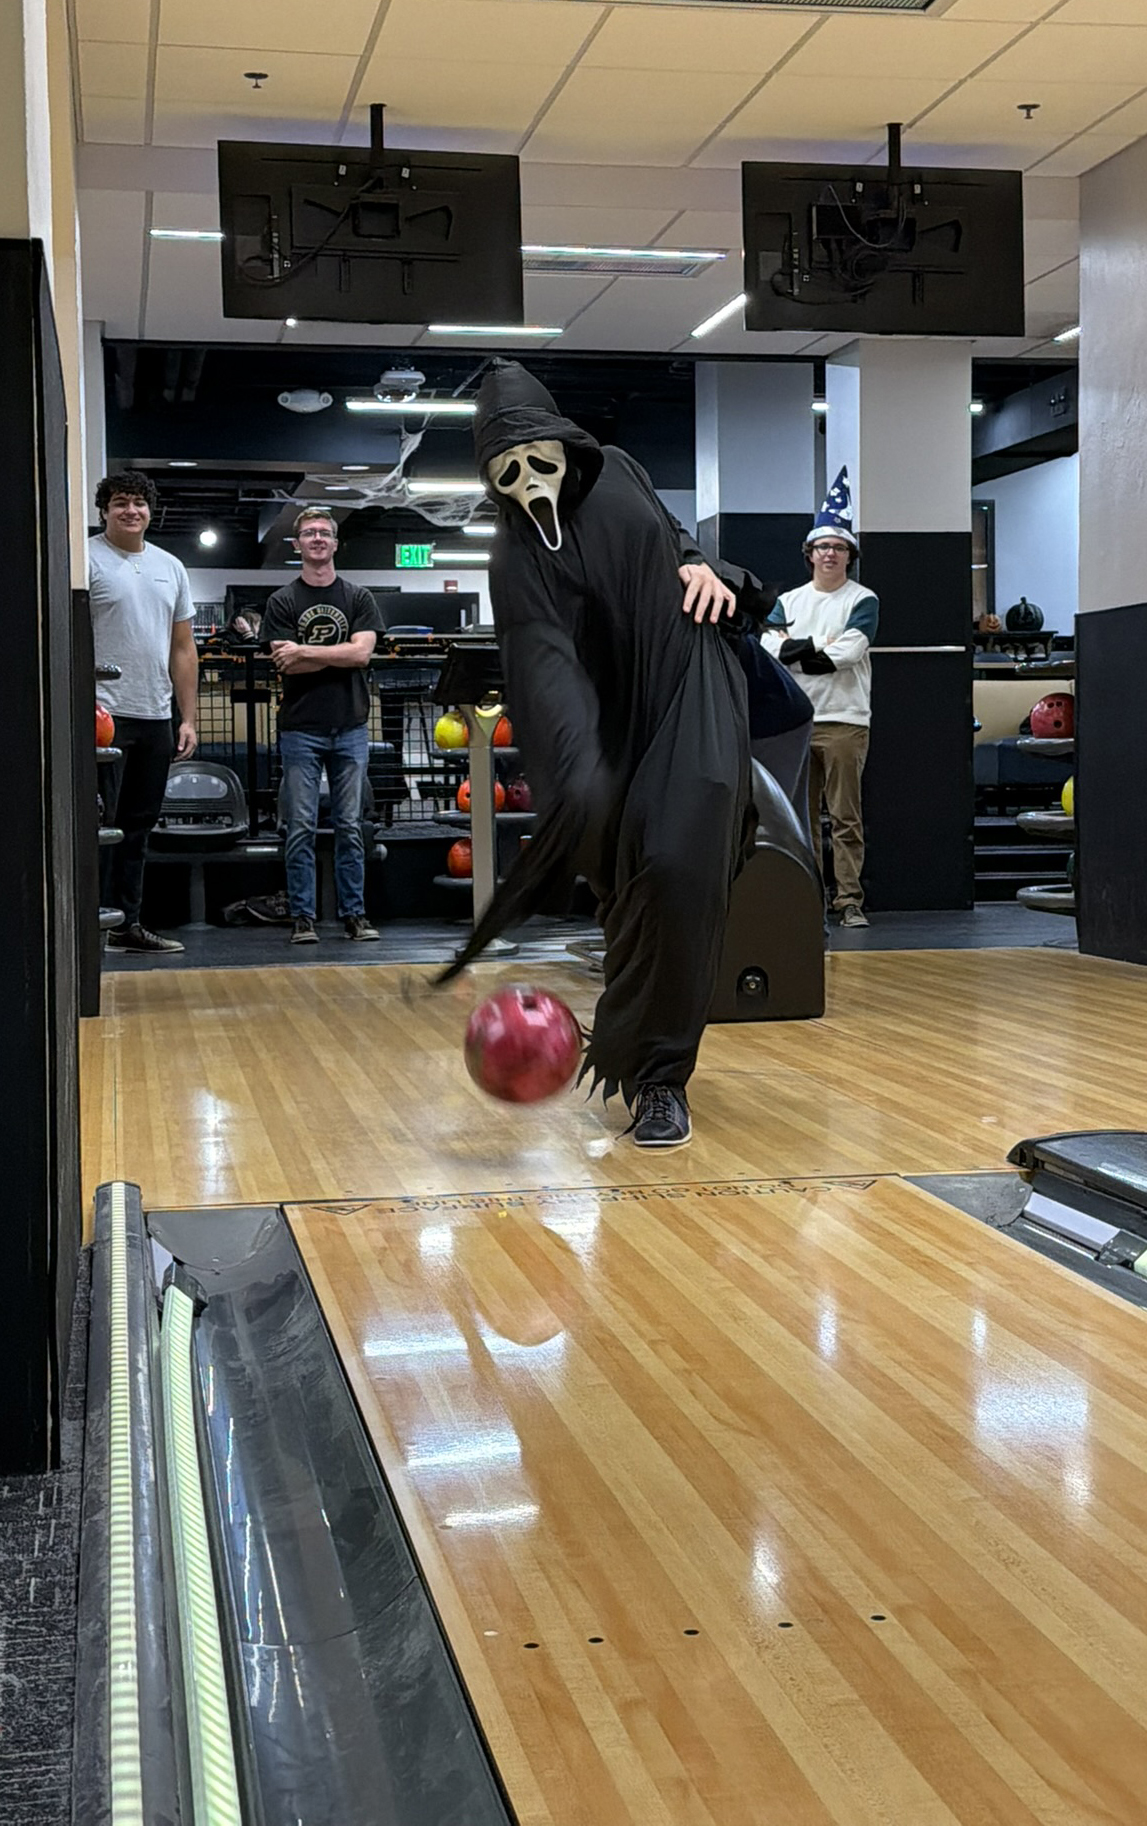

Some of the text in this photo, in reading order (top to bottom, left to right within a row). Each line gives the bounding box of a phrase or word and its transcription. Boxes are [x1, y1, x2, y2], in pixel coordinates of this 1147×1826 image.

[401, 545, 430, 565] EXIT
[308, 624, 337, 643] P
[695, 1186, 832, 1197] CAUTION
[375, 1202, 525, 1213] SURFACE
